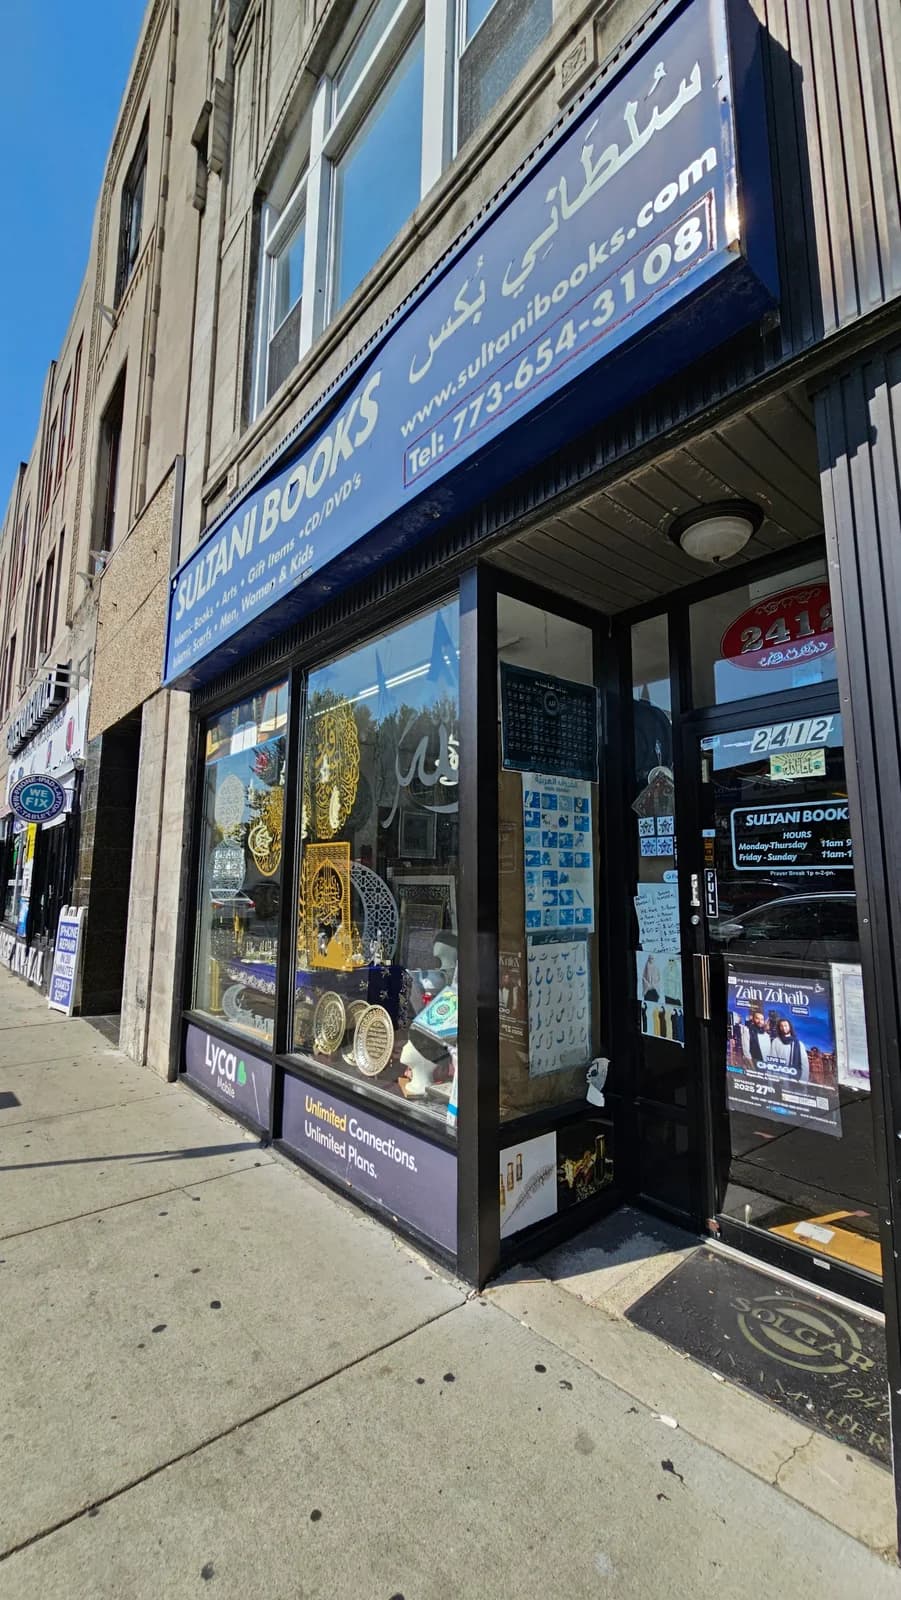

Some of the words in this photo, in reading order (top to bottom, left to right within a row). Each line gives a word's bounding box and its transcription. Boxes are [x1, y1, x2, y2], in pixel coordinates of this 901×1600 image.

[401, 147, 717, 437] www.sultanibooks.com
[408, 431, 444, 474] Tel:
[453, 217, 703, 440] 773-654-3108
[176, 503, 258, 621] SULTANI
[259, 371, 382, 544] BOOKS
[194, 607, 214, 630] Books
[222, 585, 238, 606] Arts
[247, 560, 266, 584] Gift
[267, 538, 295, 568] Items
[241, 577, 276, 612] Women
[279, 565, 287, 583] &
[290, 544, 315, 574] Kids
[753, 719, 828, 751] 2412
[26, 797, 49, 808] FIX
[30, 788, 48, 798] WE
[746, 811, 801, 826] SULTANI
[803, 807, 850, 822] BOOK
[738, 841, 808, 851] Monday-Thursday
[783, 831, 812, 839] HOURS
[739, 853, 762, 862] Friday
[767, 853, 797, 862] Sunday
[707, 872, 716, 914] PULL
[735, 985, 763, 1001] Zain
[764, 987, 809, 1006] Zohaib
[205, 1034, 237, 1082] Lyca
[756, 1061, 798, 1076] CHICAGO
[217, 1075, 236, 1098] Mobile
[734, 1082, 756, 1093] 2025
[756, 1083, 776, 1096] 27th
[304, 1119, 346, 1159] Unlimited
[348, 1144, 378, 1179] Plans.
[305, 1095, 347, 1132] Unlimited
[348, 1118, 418, 1173] Connections.
[730, 1297, 876, 1372] SOLGAR
